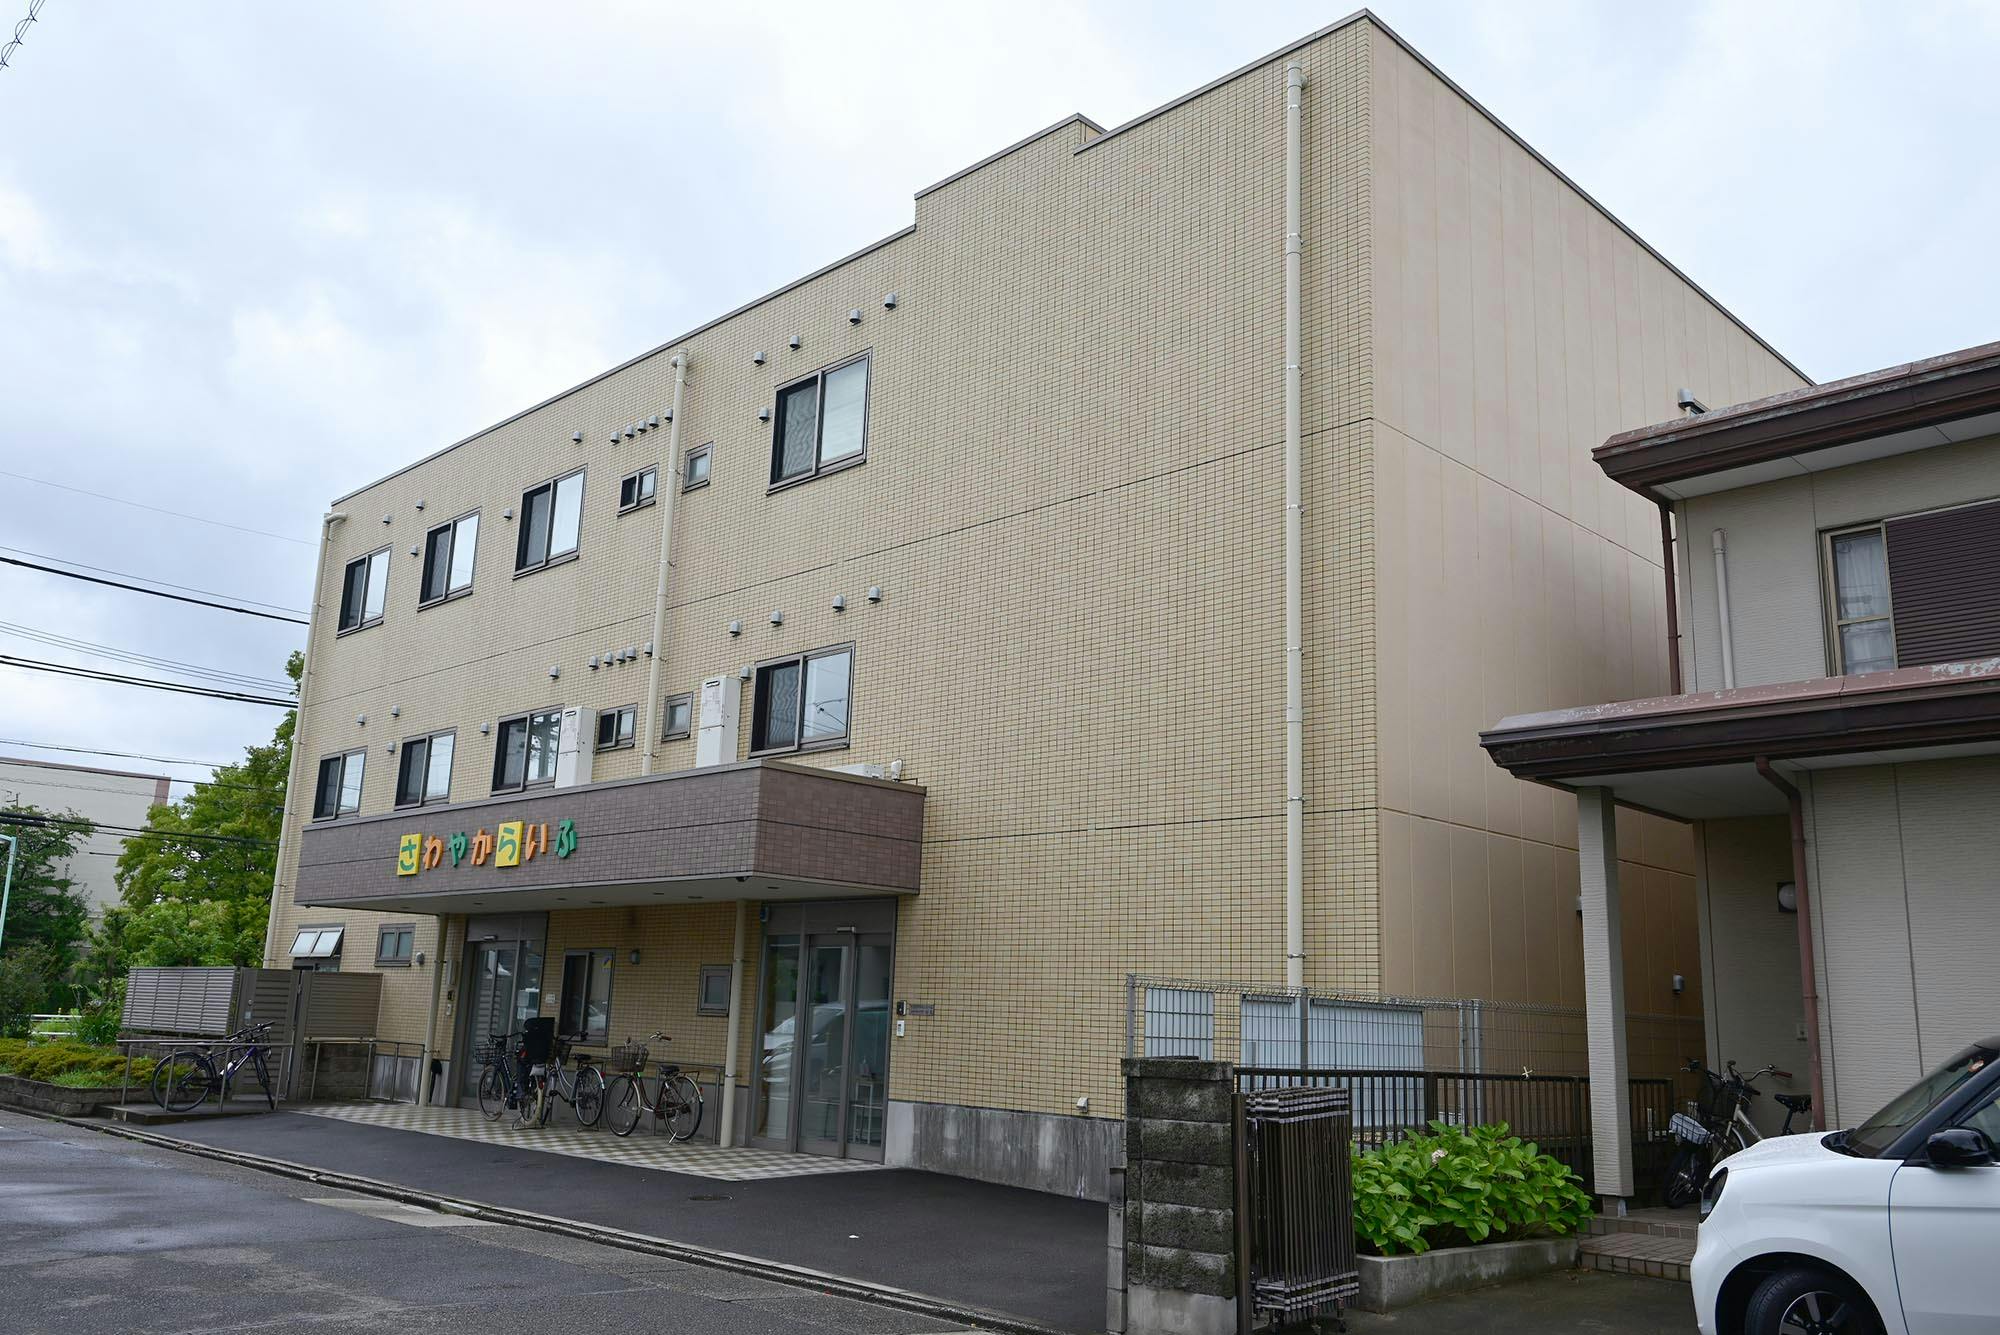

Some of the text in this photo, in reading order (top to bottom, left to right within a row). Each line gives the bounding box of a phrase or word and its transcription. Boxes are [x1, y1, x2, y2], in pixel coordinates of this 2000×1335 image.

[397, 818, 577, 876] さわやからいふ
